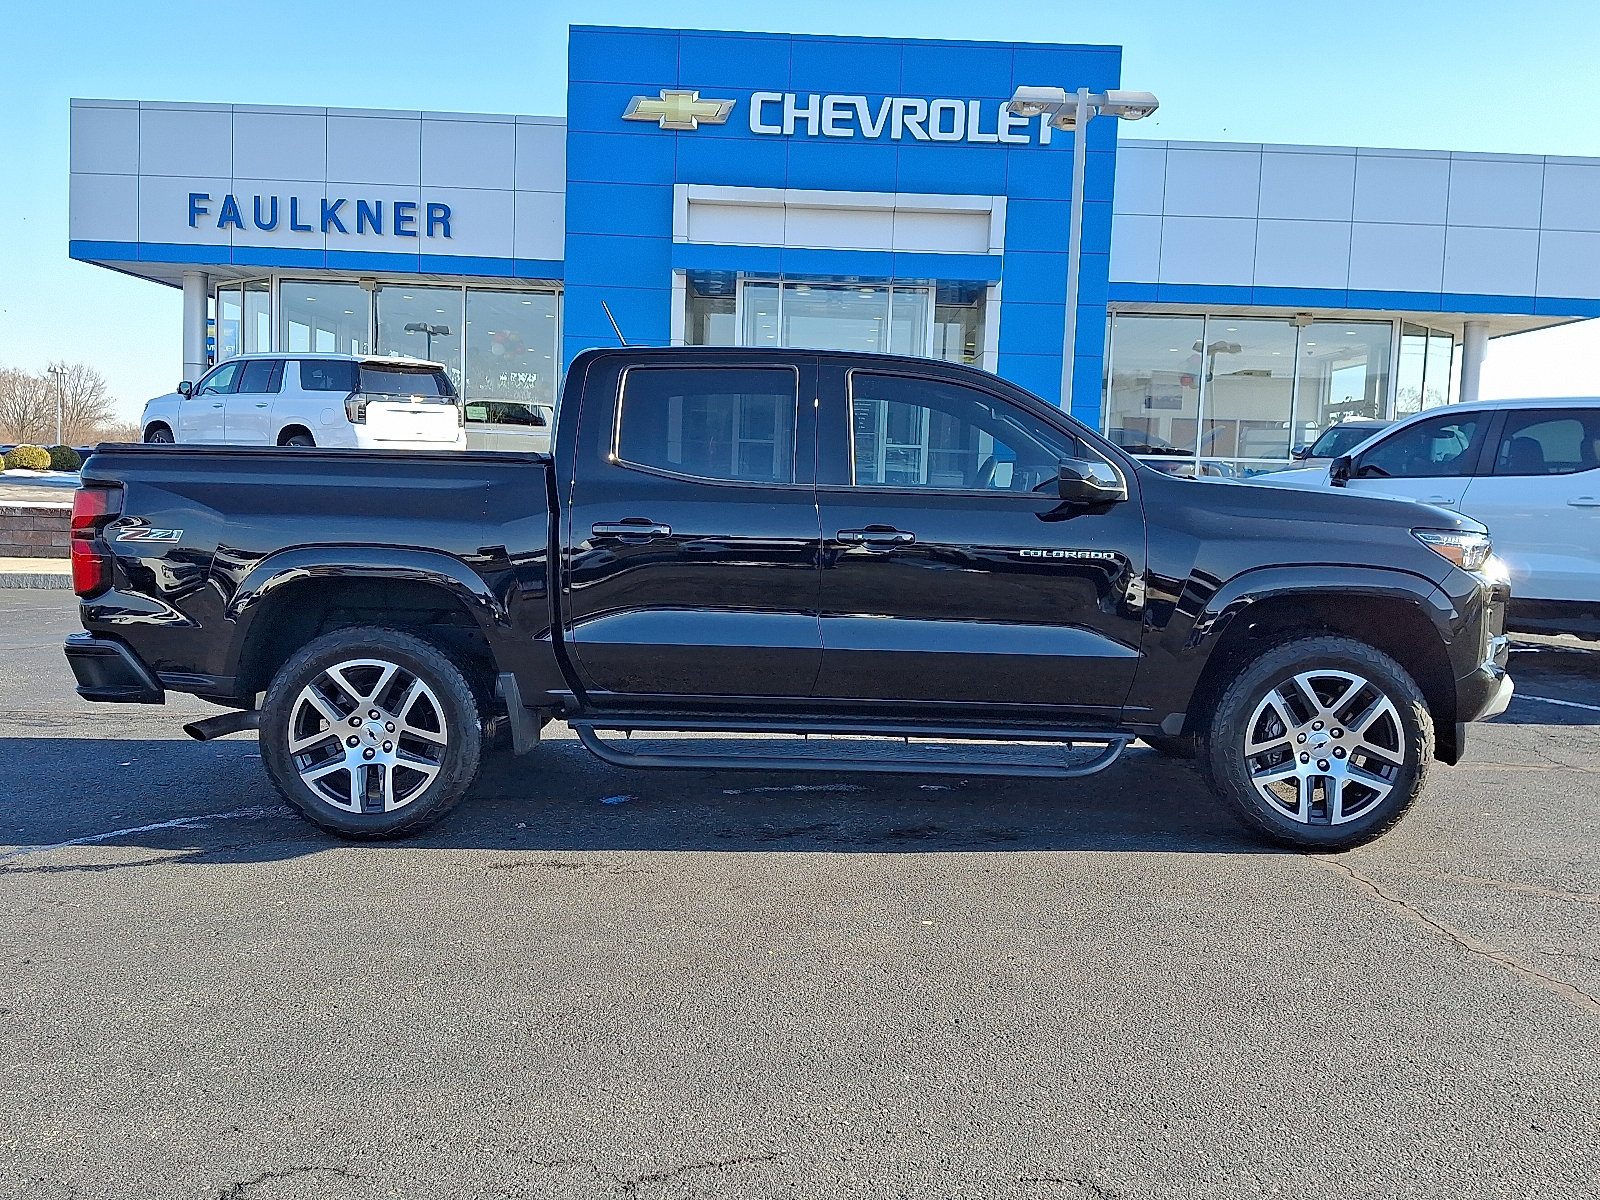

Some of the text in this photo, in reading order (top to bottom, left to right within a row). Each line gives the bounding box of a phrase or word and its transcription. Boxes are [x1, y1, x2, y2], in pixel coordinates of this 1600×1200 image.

[188, 192, 453, 239] FAULKNER
[116, 527, 184, 543] Z71
[1019, 549, 1116, 561] COLORADO
